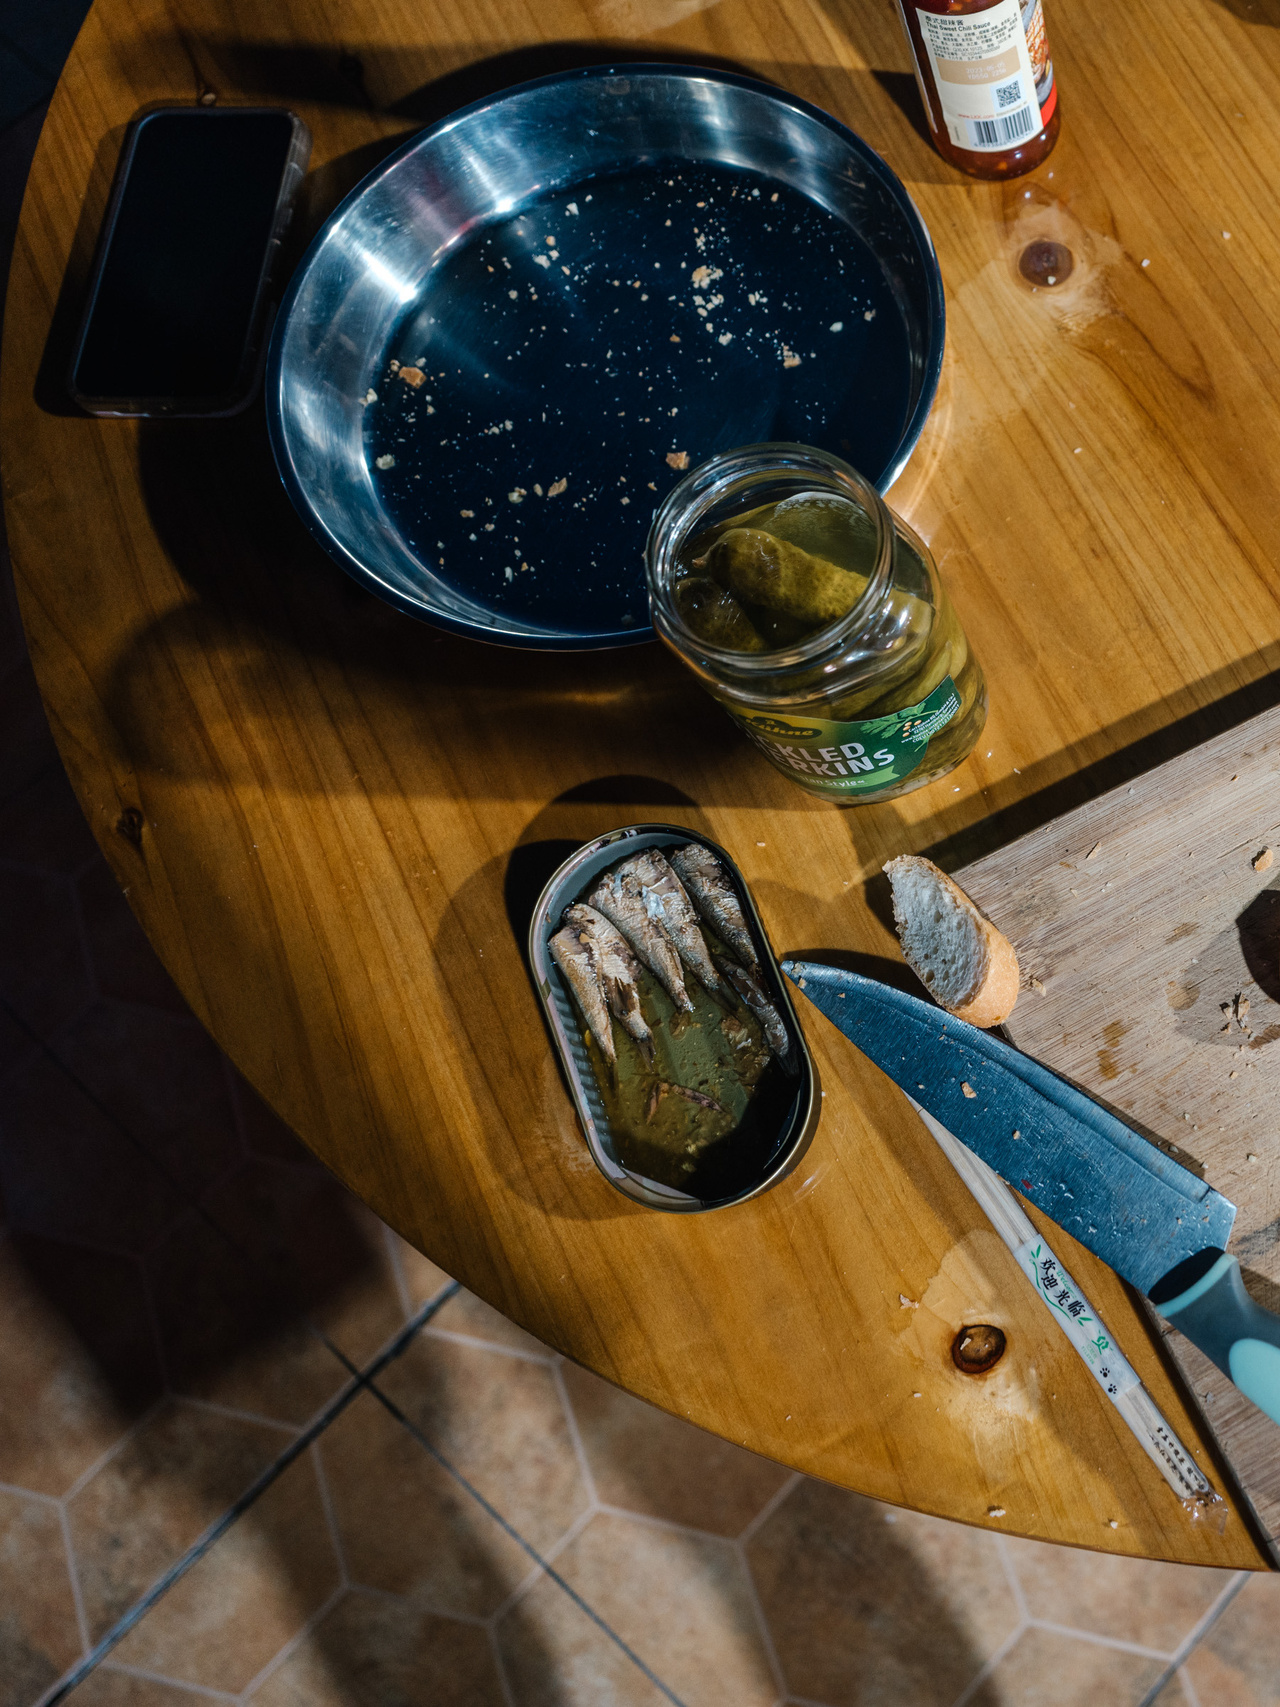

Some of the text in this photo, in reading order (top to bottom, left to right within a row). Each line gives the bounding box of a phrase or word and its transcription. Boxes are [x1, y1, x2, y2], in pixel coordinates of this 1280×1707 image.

[940, 24, 957, 32] Sweet
[973, 21, 991, 30] Sauce
[1040, 1256, 1086, 1318] 欢迎光临
